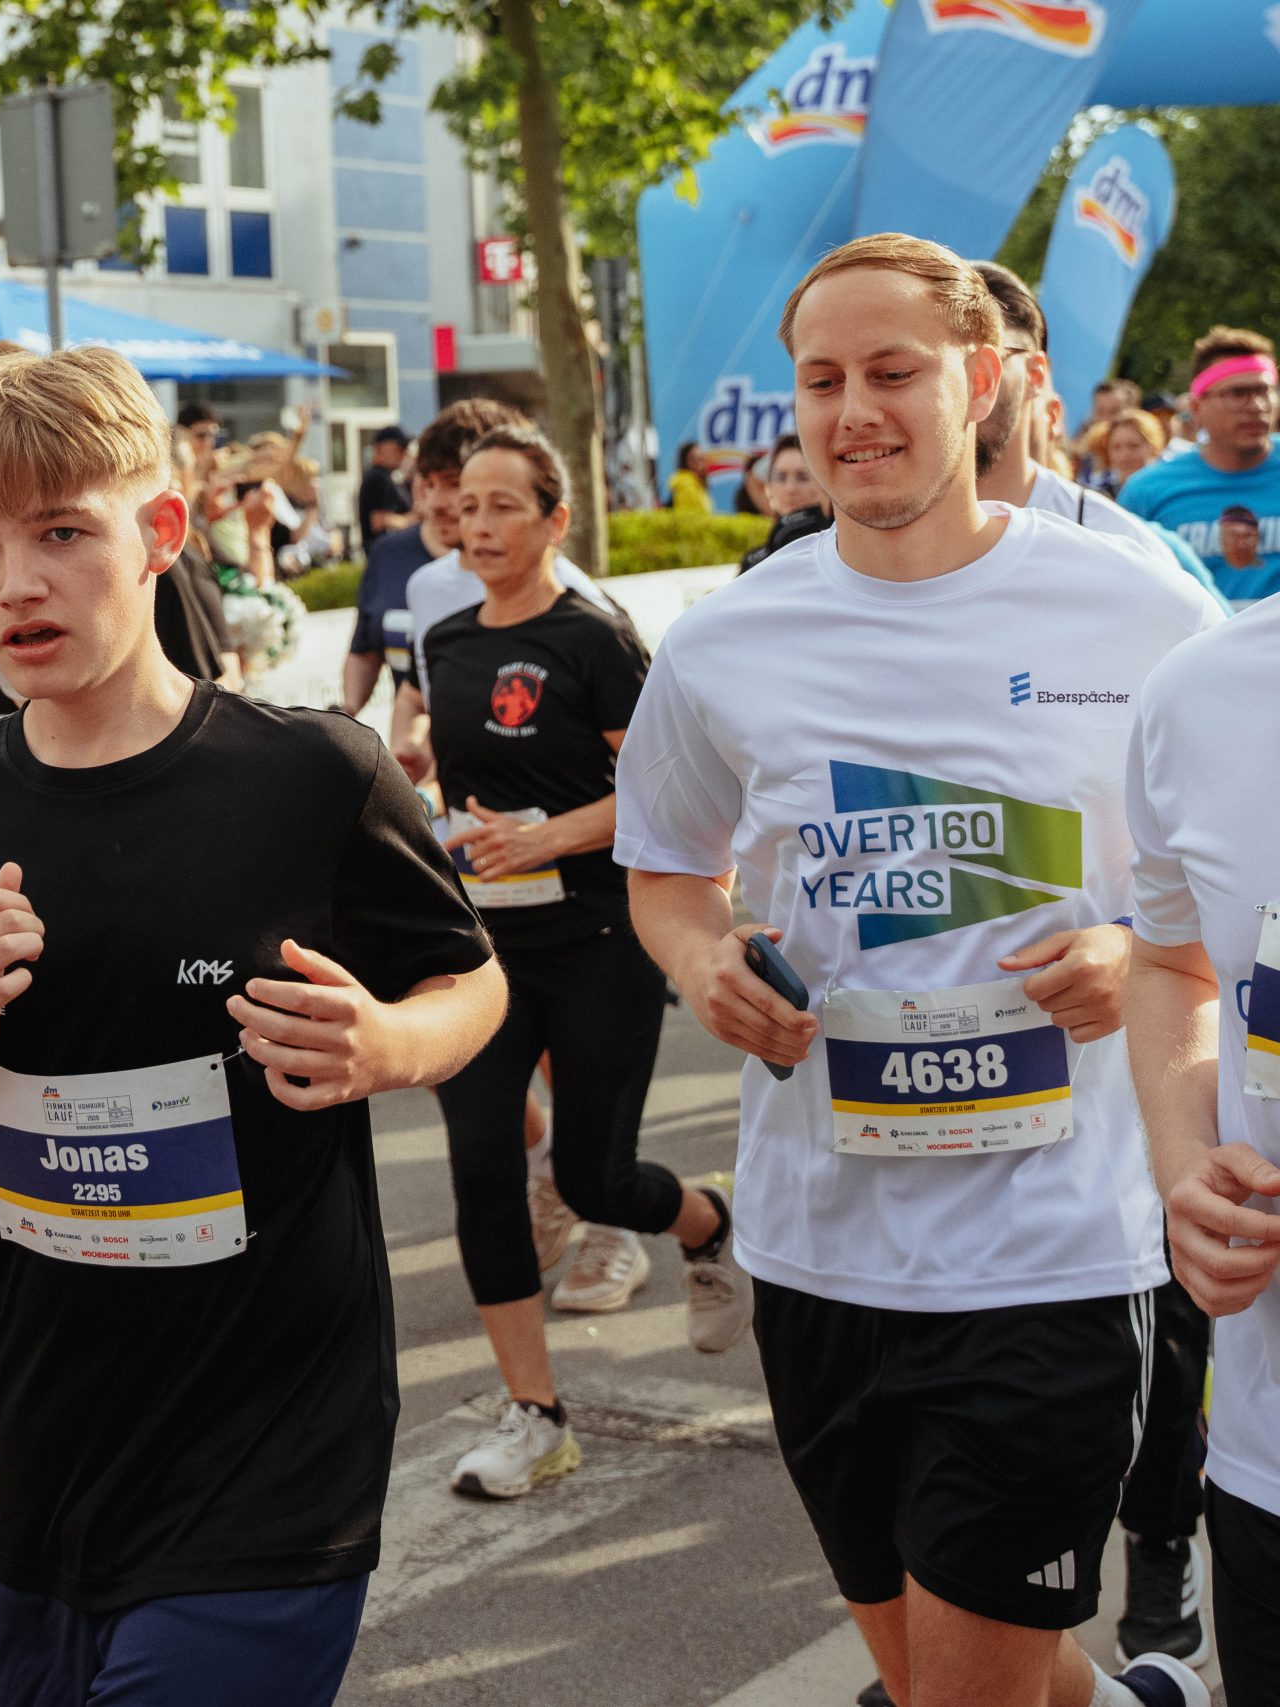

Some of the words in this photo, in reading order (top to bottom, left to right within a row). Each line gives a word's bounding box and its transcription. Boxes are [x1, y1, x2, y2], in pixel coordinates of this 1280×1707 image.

[1094, 168, 1142, 231] dm
[708, 384, 796, 446] dm
[1037, 690, 1130, 705] Eberspächer
[798, 814, 915, 859] OVER
[924, 810, 996, 850] 160
[801, 870, 945, 909] YEARS
[904, 1013, 927, 1021] FIRMEN
[904, 1021, 928, 1031] LAUF
[881, 1044, 1008, 1094] 4638
[44, 1086, 58, 1095] dm
[46, 1102, 72, 1110] FIRMEN
[78, 1102, 105, 1110] HOMBURG
[48, 1111, 73, 1122] LAUF
[863, 1124, 878, 1133] dm
[927, 1142, 974, 1150] WOCHENSPIEGEL
[40, 1138, 149, 1172] Jonas
[72, 1183, 122, 1202] 2295
[71, 1208, 100, 1217] STARTZEIT
[21, 1217, 34, 1228] dm
[81, 1250, 130, 1259] WOCHENSPIEGEL
